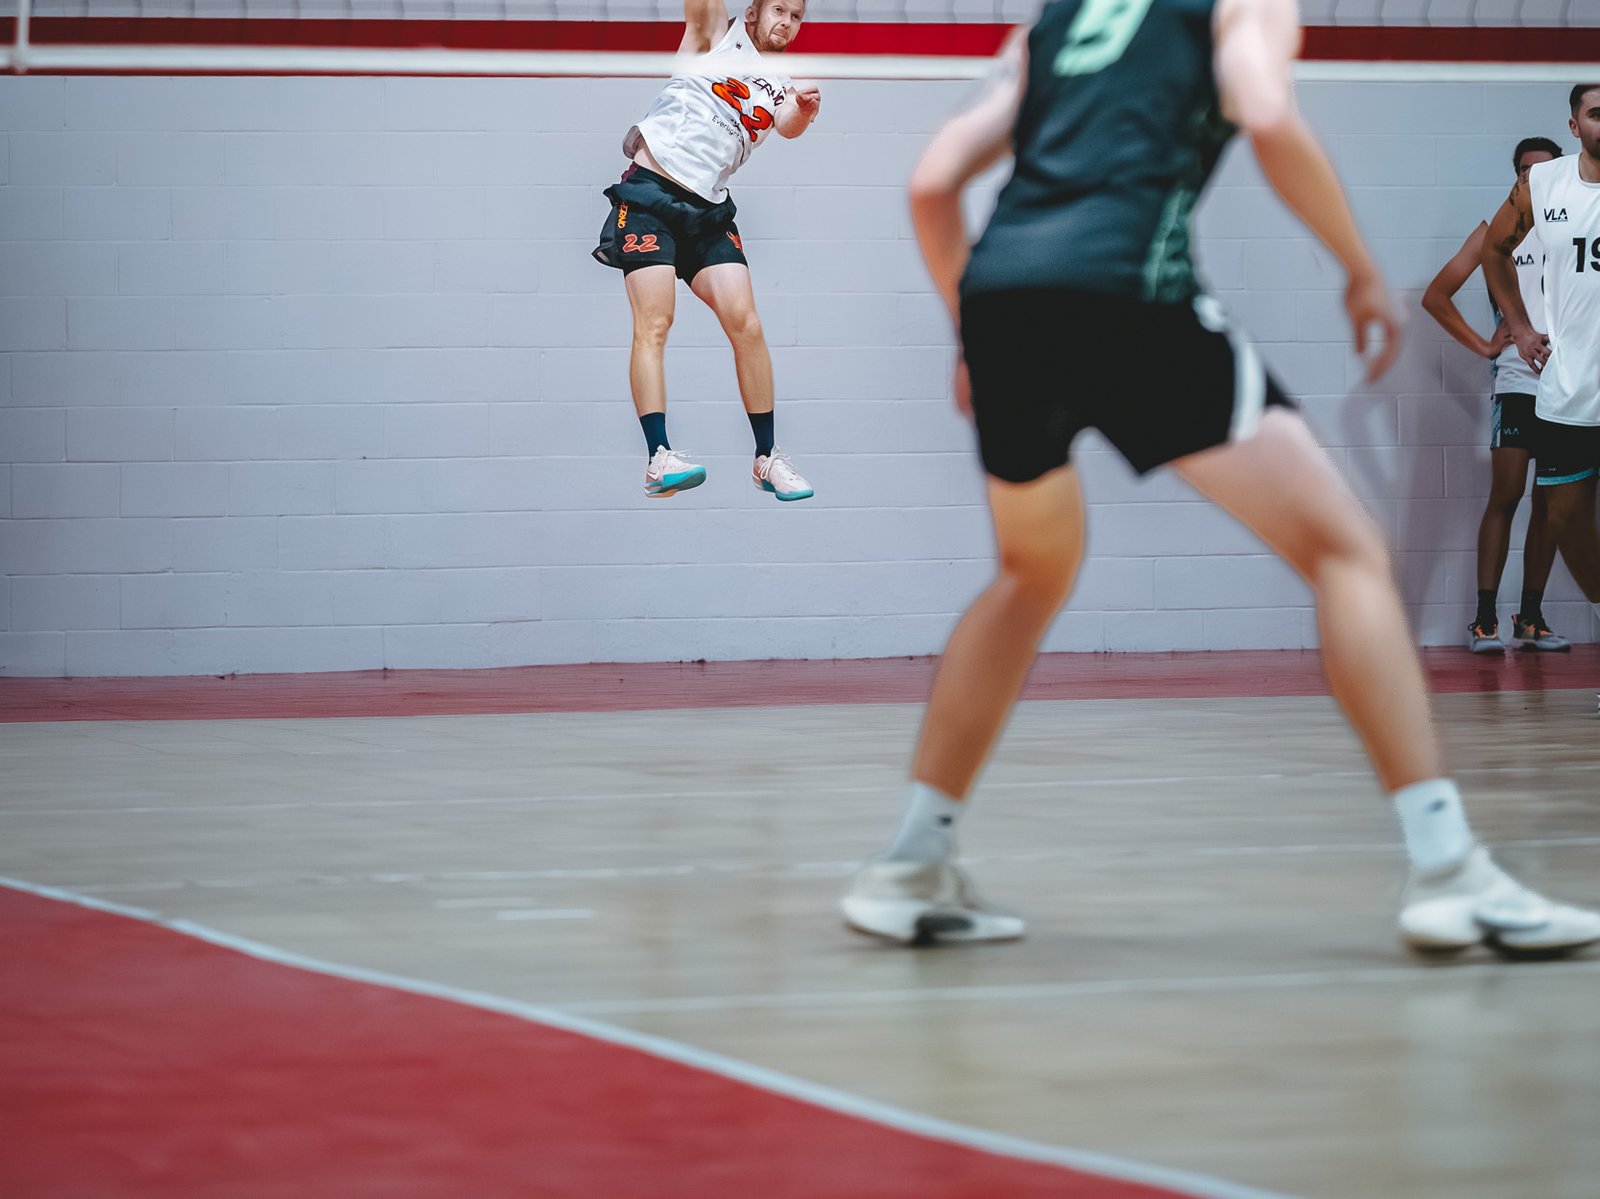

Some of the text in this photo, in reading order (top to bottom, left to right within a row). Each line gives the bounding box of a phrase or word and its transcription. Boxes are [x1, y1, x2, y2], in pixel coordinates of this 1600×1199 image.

[712, 77, 774, 142] 22
[1544, 208, 1568, 220] VLA
[623, 234, 660, 252] 22
[1513, 254, 1535, 266] VLA
[1503, 427, 1519, 435] VLA
